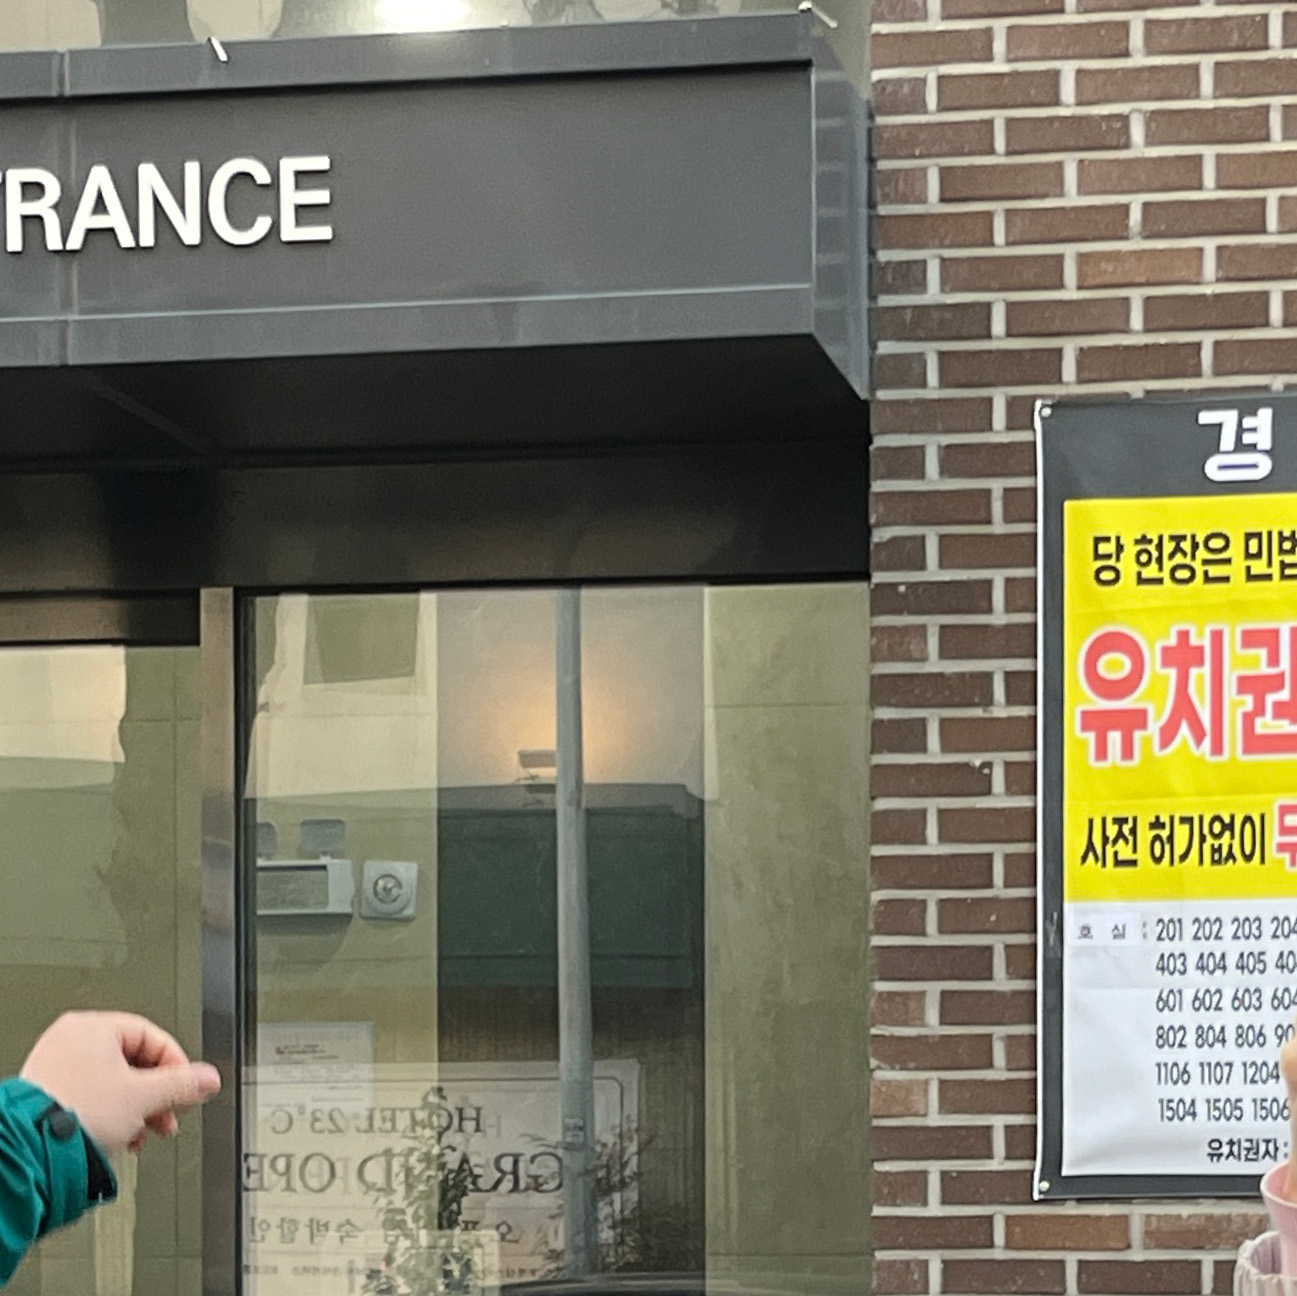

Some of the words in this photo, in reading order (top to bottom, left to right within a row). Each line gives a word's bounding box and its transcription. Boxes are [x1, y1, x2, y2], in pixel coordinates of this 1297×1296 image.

[1092, 534, 1125, 587] 당
[1133, 531, 1233, 586] 현장은
[1079, 812, 1139, 868] 사전
[1148, 811, 1267, 868] 허가없이
[1155, 917, 1184, 942] 201
[1191, 916, 1223, 941] 202
[1230, 915, 1263, 940] 203
[1155, 952, 1188, 976] 403
[1195, 951, 1227, 976] 404
[1234, 951, 1267, 975] 405
[1155, 988, 1184, 1012] 601
[1191, 987, 1223, 1012] 602
[1230, 987, 1263, 1011] 603
[1155, 1024, 1188, 1049] 802
[1194, 1024, 1227, 1048] 804
[1234, 1023, 1267, 1048] 806
[1274, 1023, 1296, 1048] 90
[1155, 1061, 1191, 1086] 1106
[1198, 1061, 1234, 1085] 1107
[1241, 1060, 1281, 1085] 1204
[1158, 1098, 1198, 1122] 1504
[1205, 1097, 1244, 1122] 1505
[1251, 1097, 1291, 1121] 1506
